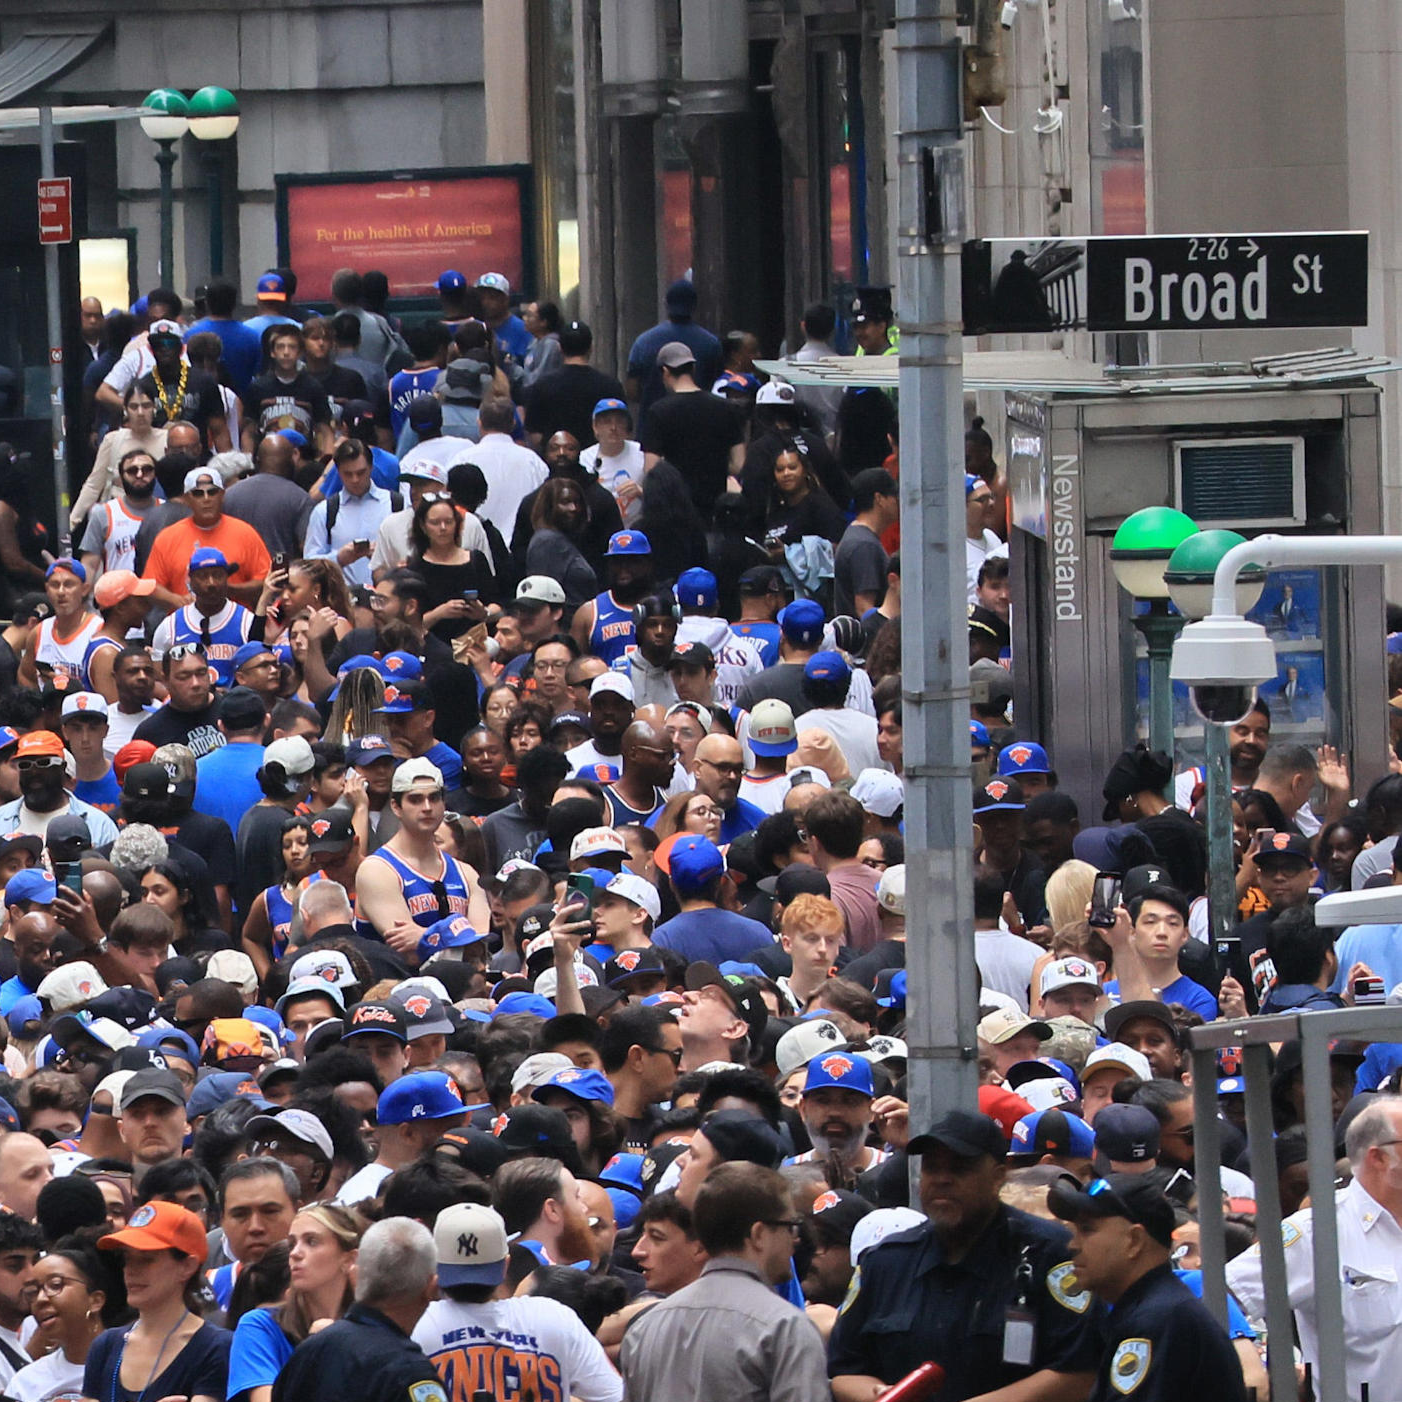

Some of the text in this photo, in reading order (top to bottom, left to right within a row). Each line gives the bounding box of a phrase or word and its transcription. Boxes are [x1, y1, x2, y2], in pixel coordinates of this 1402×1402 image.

[317, 222, 493, 242] For the health of America
[1188, 240, 1229, 261] 2-26
[1125, 254, 1325, 323] Broad St
[1052, 454, 1083, 621] Newsstand
[601, 621, 633, 642] NEW
[407, 896, 437, 917] NEW
[352, 1006, 396, 1026] Knicks
[457, 1233, 479, 1257] NY
[442, 1325, 482, 1347] NEW
